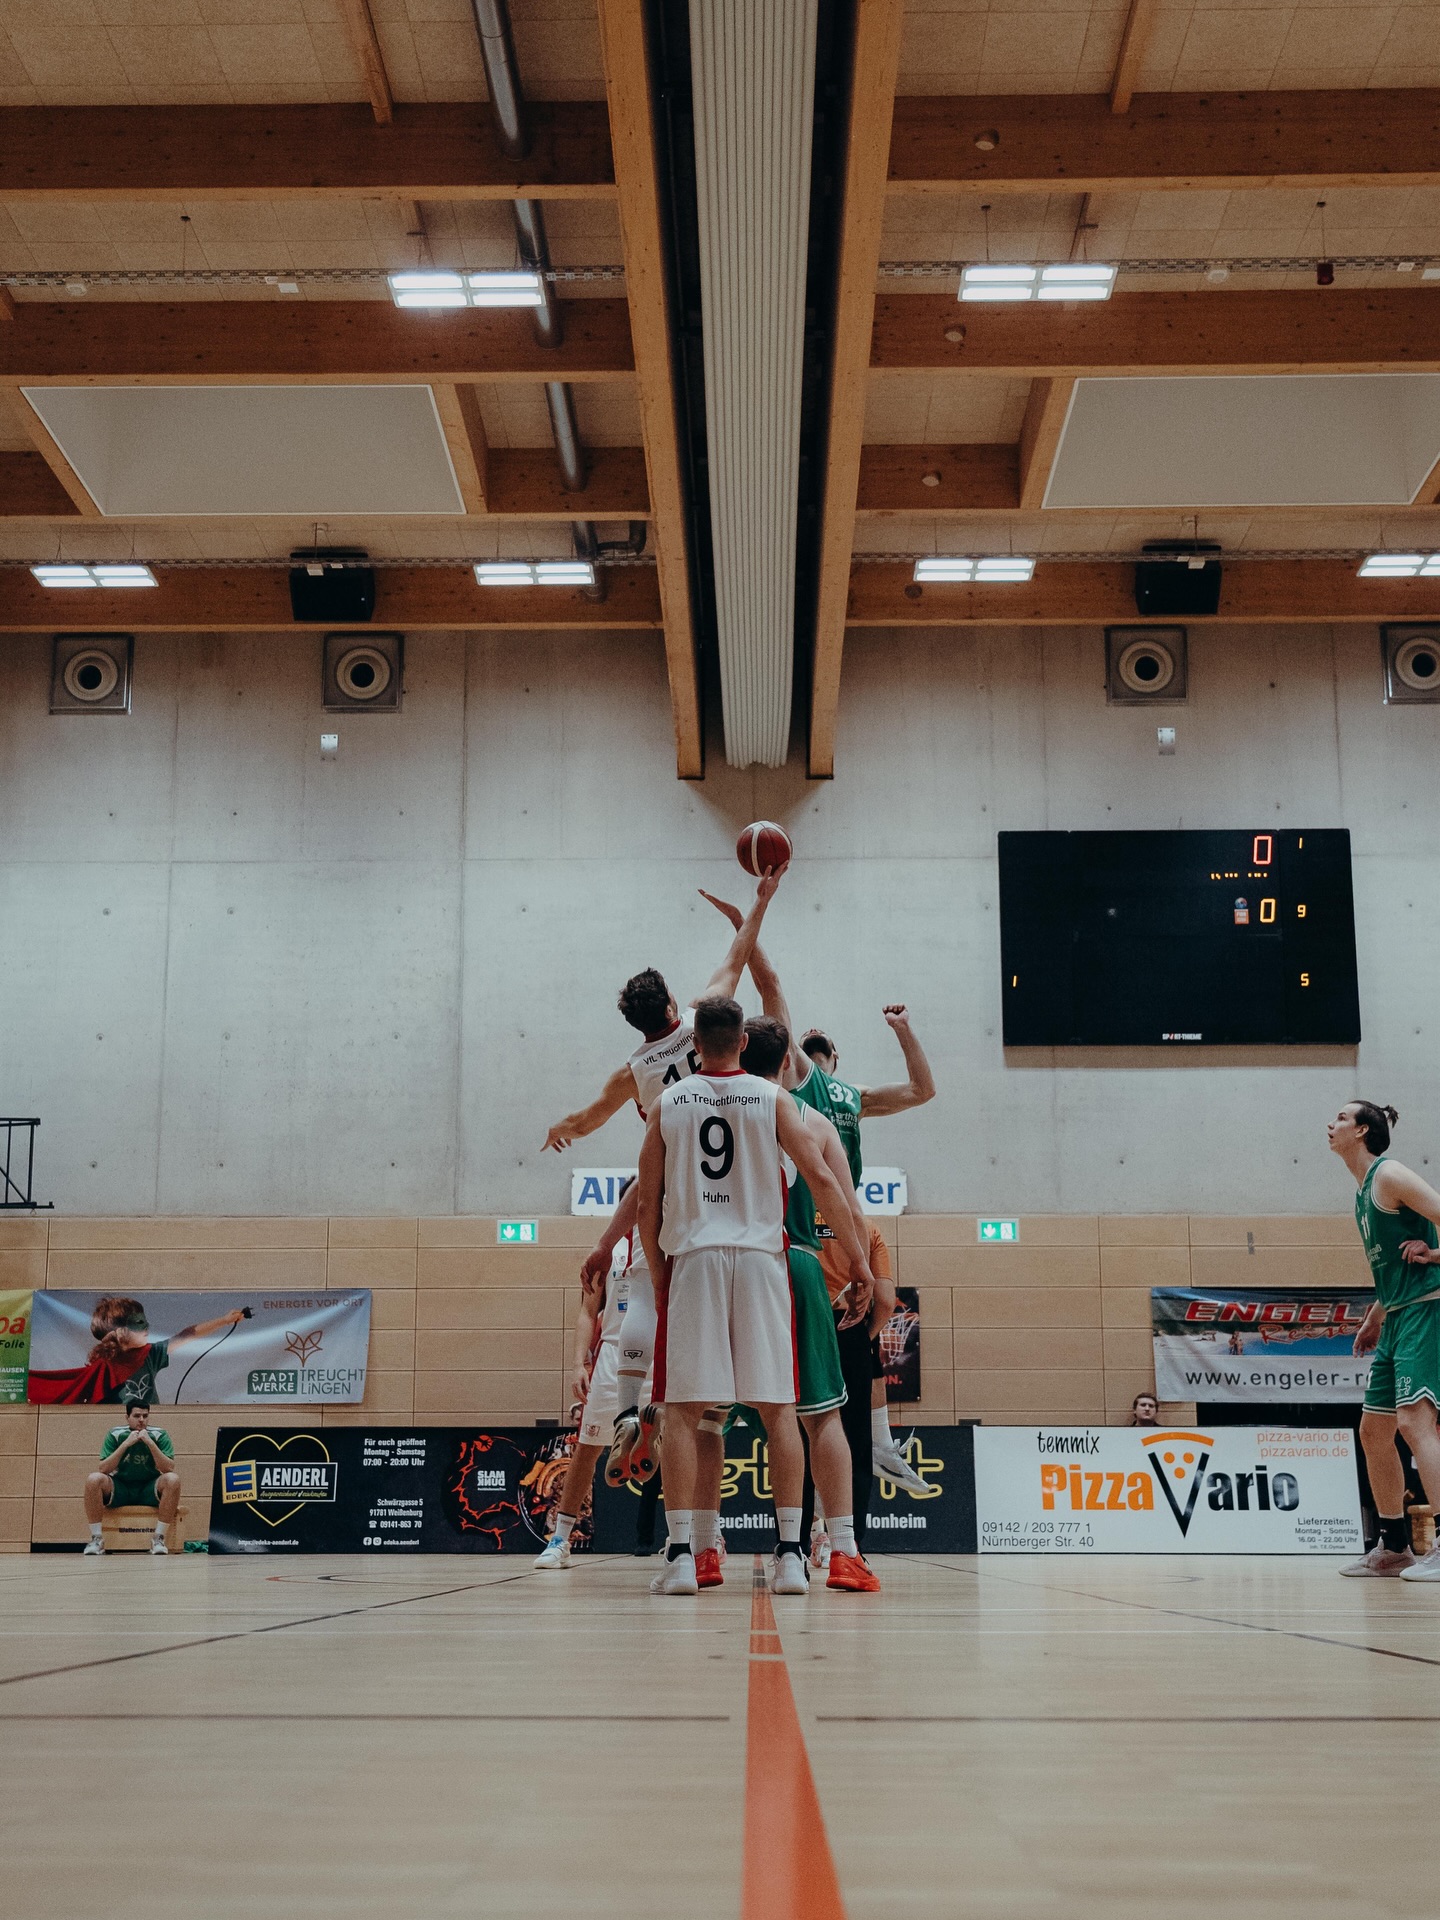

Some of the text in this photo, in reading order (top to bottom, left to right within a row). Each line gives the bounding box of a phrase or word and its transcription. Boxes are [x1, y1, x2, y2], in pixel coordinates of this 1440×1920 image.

[1253, 835, 1272, 865] 0
[1260, 898, 1276, 923] 0
[1297, 904, 1307, 918] 9
[1301, 973, 1310, 987] 5
[643, 1055, 657, 1066] VfL
[673, 1093, 761, 1107] VfL Treuchtlingen
[699, 1115, 735, 1181] 9
[702, 1190, 730, 1204] Huhn
[263, 1299, 313, 1309] ENERGIE
[1184, 1300, 1374, 1324] ENGEL
[251, 1368, 365, 1382] STADT TREUCHT
[251, 1382, 295, 1392] WERKE
[364, 1438, 426, 1448] Für euch geöffnet
[1036, 1430, 1350, 1454] temmix pizza-vario.de
[363, 1448, 390, 1457] Montag
[396, 1448, 426, 1457] Samstag
[1260, 1445, 1349, 1460] pizzavario.de
[362, 1458, 383, 1466] 07:00
[389, 1458, 409, 1466] 20:00
[411, 1458, 425, 1466] Uhr
[261, 1468, 329, 1487] AENDERL
[477, 1470, 505, 1478] SLAM
[1041, 1464, 1154, 1511] Pizza
[225, 1492, 254, 1501] EDEKA
[387, 1508, 423, 1518] Weißenburg
[982, 1522, 1020, 1533] 09142
[1031, 1522, 1055, 1533] 203
[1058, 1522, 1081, 1533] 777
[1085, 1522, 1091, 1533] 1
[1297, 1517, 1354, 1526] Lieferzeiten:
[1295, 1527, 1322, 1535] Montag
[1328, 1527, 1359, 1536] Sonntag
[981, 1535, 1095, 1550] Nürnberger Str. 40
